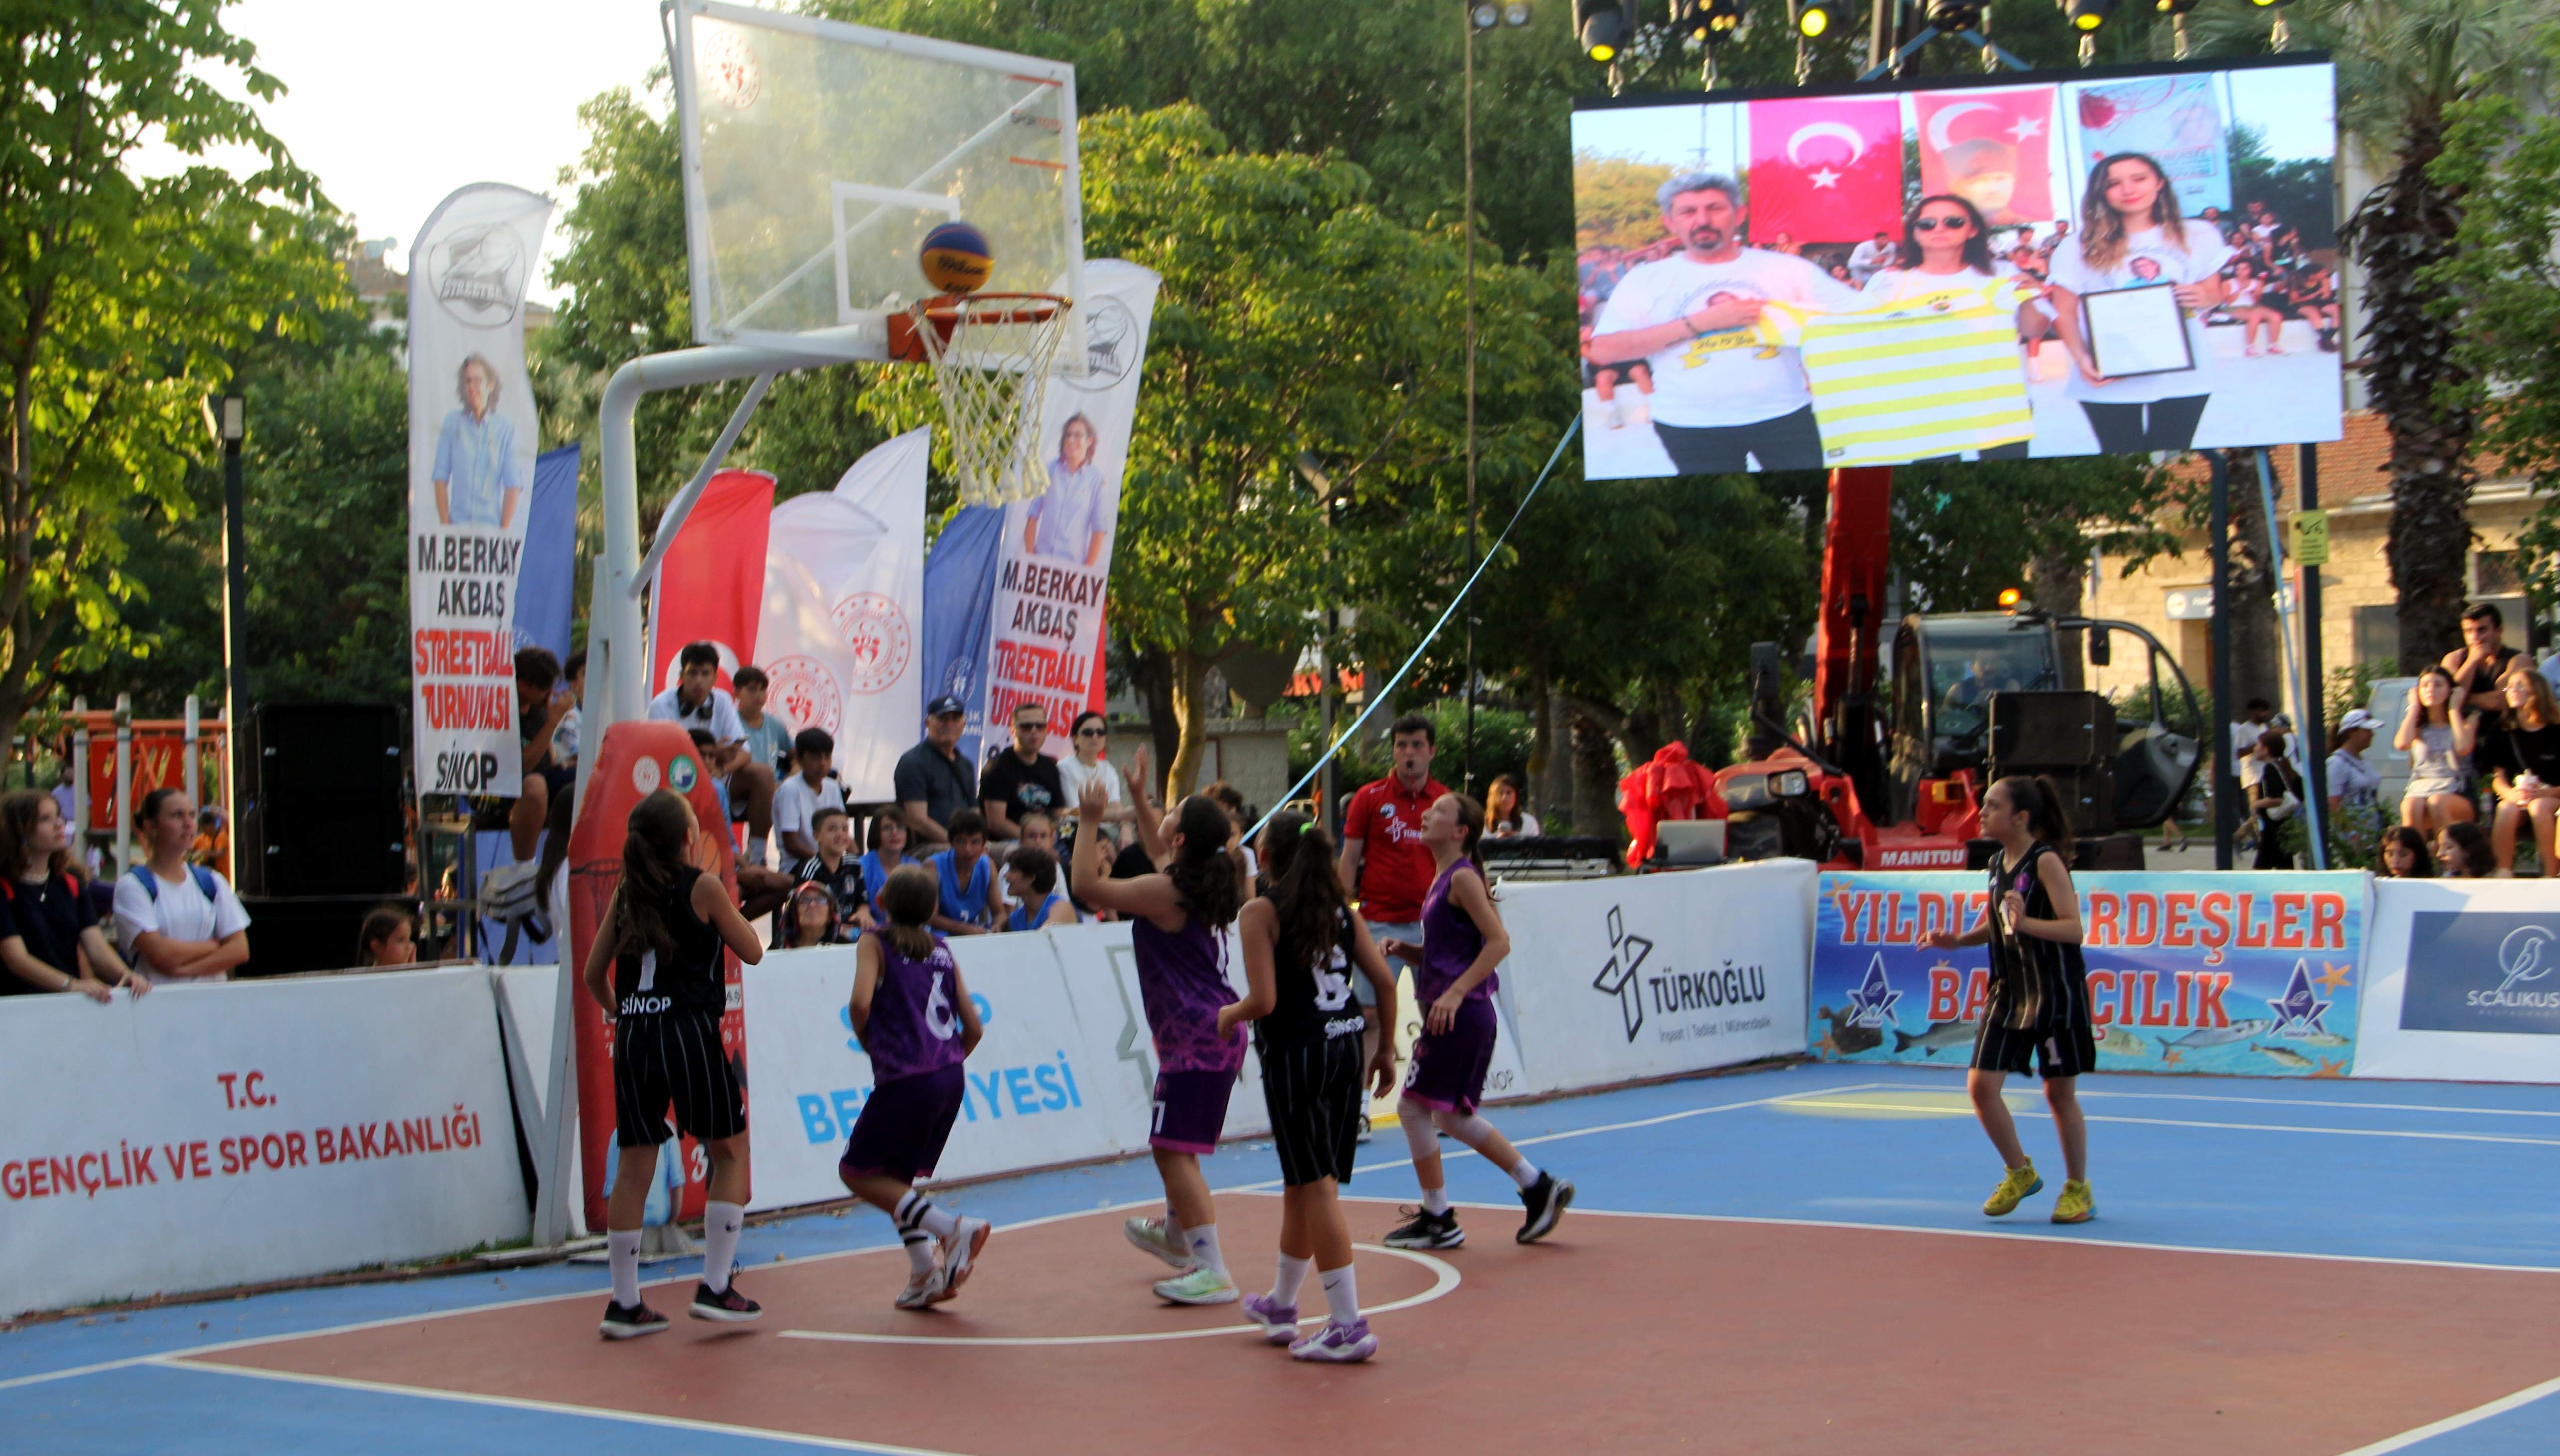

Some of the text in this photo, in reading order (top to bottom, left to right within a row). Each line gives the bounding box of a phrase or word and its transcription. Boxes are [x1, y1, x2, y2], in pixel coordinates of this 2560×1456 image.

[417, 533, 521, 576] M.BERKAY
[437, 577, 505, 627] AKBAŞ
[1001, 559, 1105, 609] M.BERKAY
[1011, 600, 1078, 642] AKBAŞ
[415, 627, 514, 677] STREETBALL
[995, 638, 1087, 695] TREETBALL
[421, 683, 510, 730] TURNUVASI
[436, 739, 499, 791] SİNOP
[1880, 849, 1965, 867] MANITOU
[2082, 891, 2346, 967] RDEŞLER
[622, 993, 671, 1015] SİNOP
[925, 970, 956, 1041] 6
[1649, 959, 1765, 1014] TÜRKOĞLU
[1927, 968, 2232, 1042] BAÇILIK
[218, 1070, 277, 1109] T.C.
[1, 1103, 482, 1200] GENÇLİK VE SPOR BAKANLIĞI
